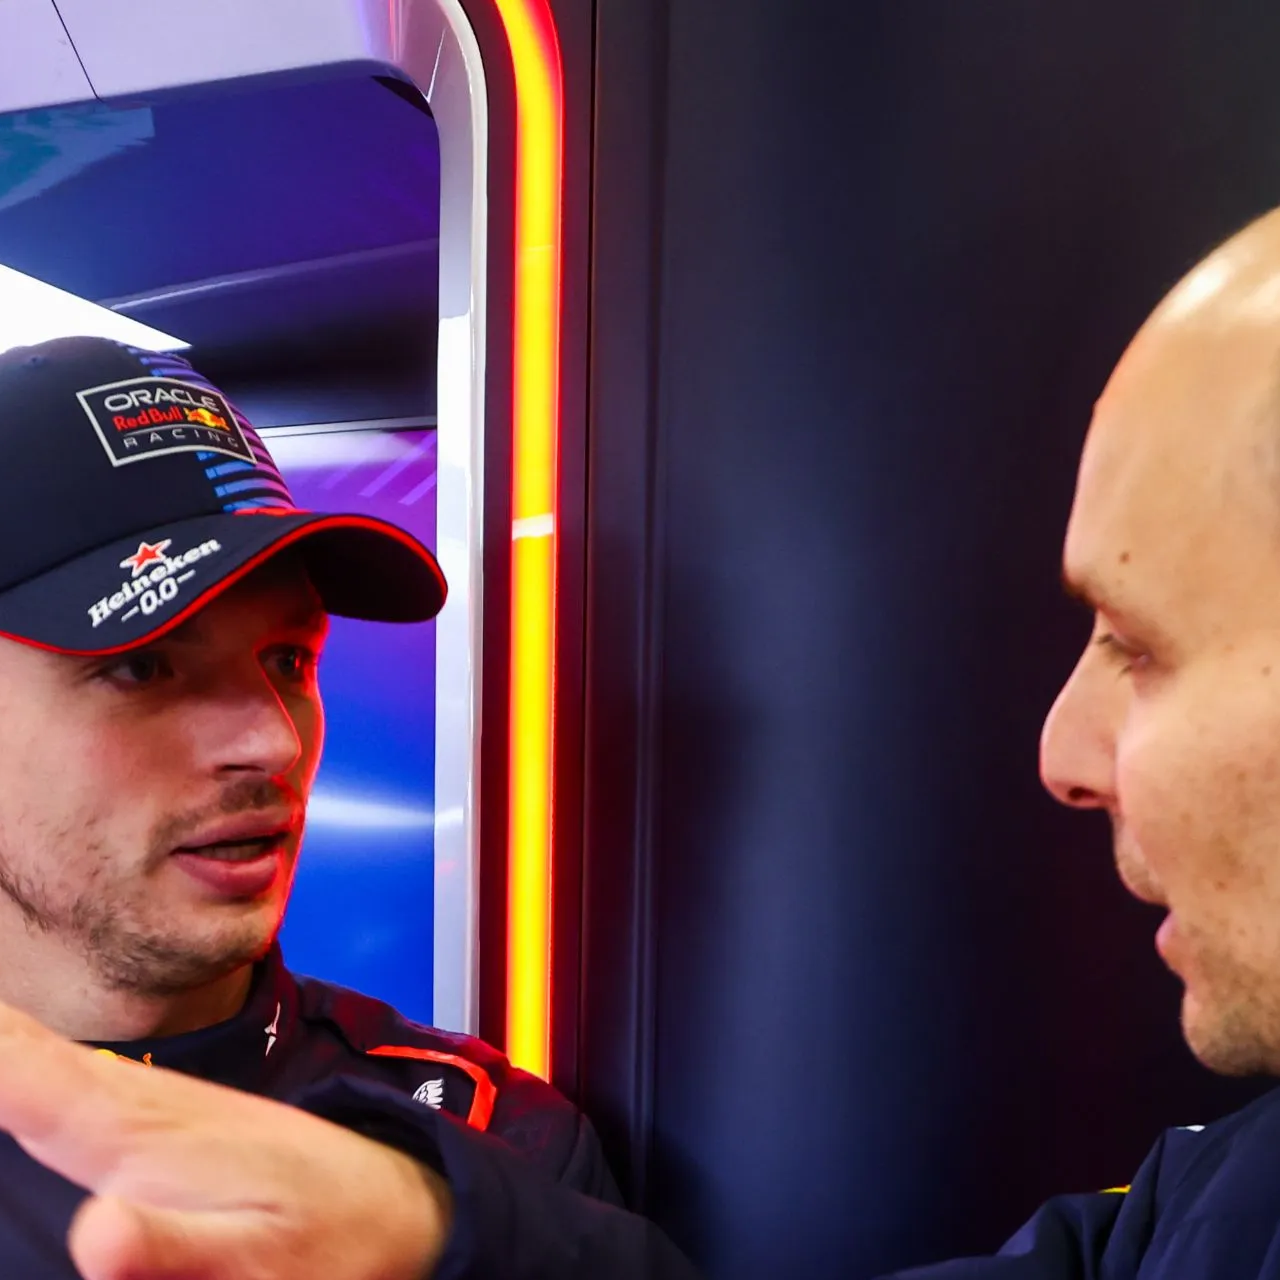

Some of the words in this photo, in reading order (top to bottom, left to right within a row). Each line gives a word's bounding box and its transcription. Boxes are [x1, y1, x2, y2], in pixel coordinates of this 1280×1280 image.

[104, 387, 221, 413] ORACLE
[122, 427, 239, 449] RACING
[87, 538, 221, 628] Heineken
